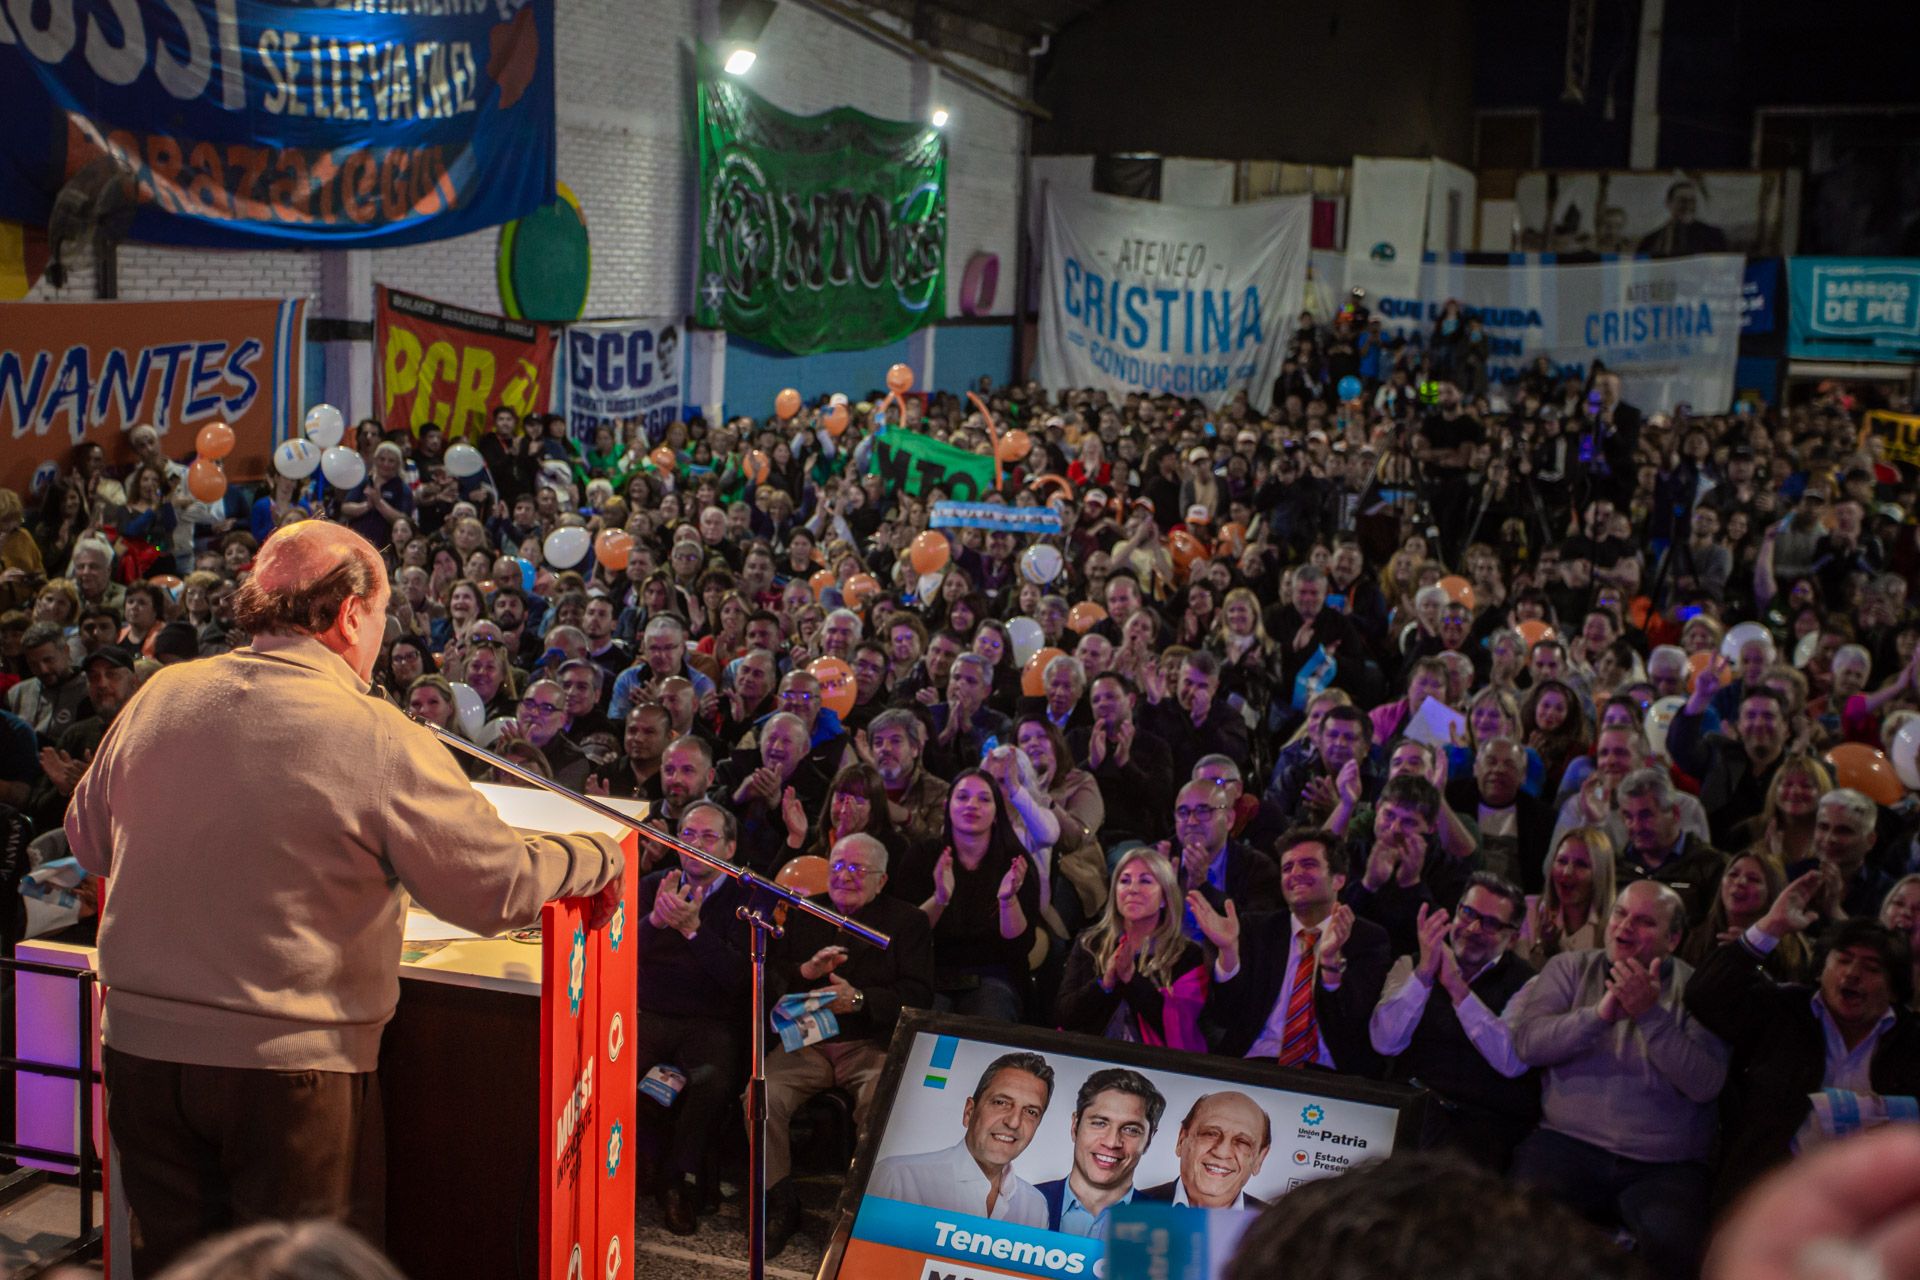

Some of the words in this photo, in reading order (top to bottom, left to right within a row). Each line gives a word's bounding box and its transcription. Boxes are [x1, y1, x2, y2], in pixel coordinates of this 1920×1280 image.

[1115, 238, 1207, 279] ATENEO
[1064, 256, 1263, 355] CRISTINA
[1584, 302, 1714, 348] CRISTINA
[1823, 300, 1858, 322] DE
[1866, 302, 1907, 324] PIE
[384, 325, 496, 440] PCR
[568, 330, 653, 392] CCC
[557, 1056, 593, 1161] MUSSI
[1315, 1152, 1349, 1165] Estado
[1320, 1130, 1368, 1149] Patria
[934, 1221, 1086, 1274] Tenemos
